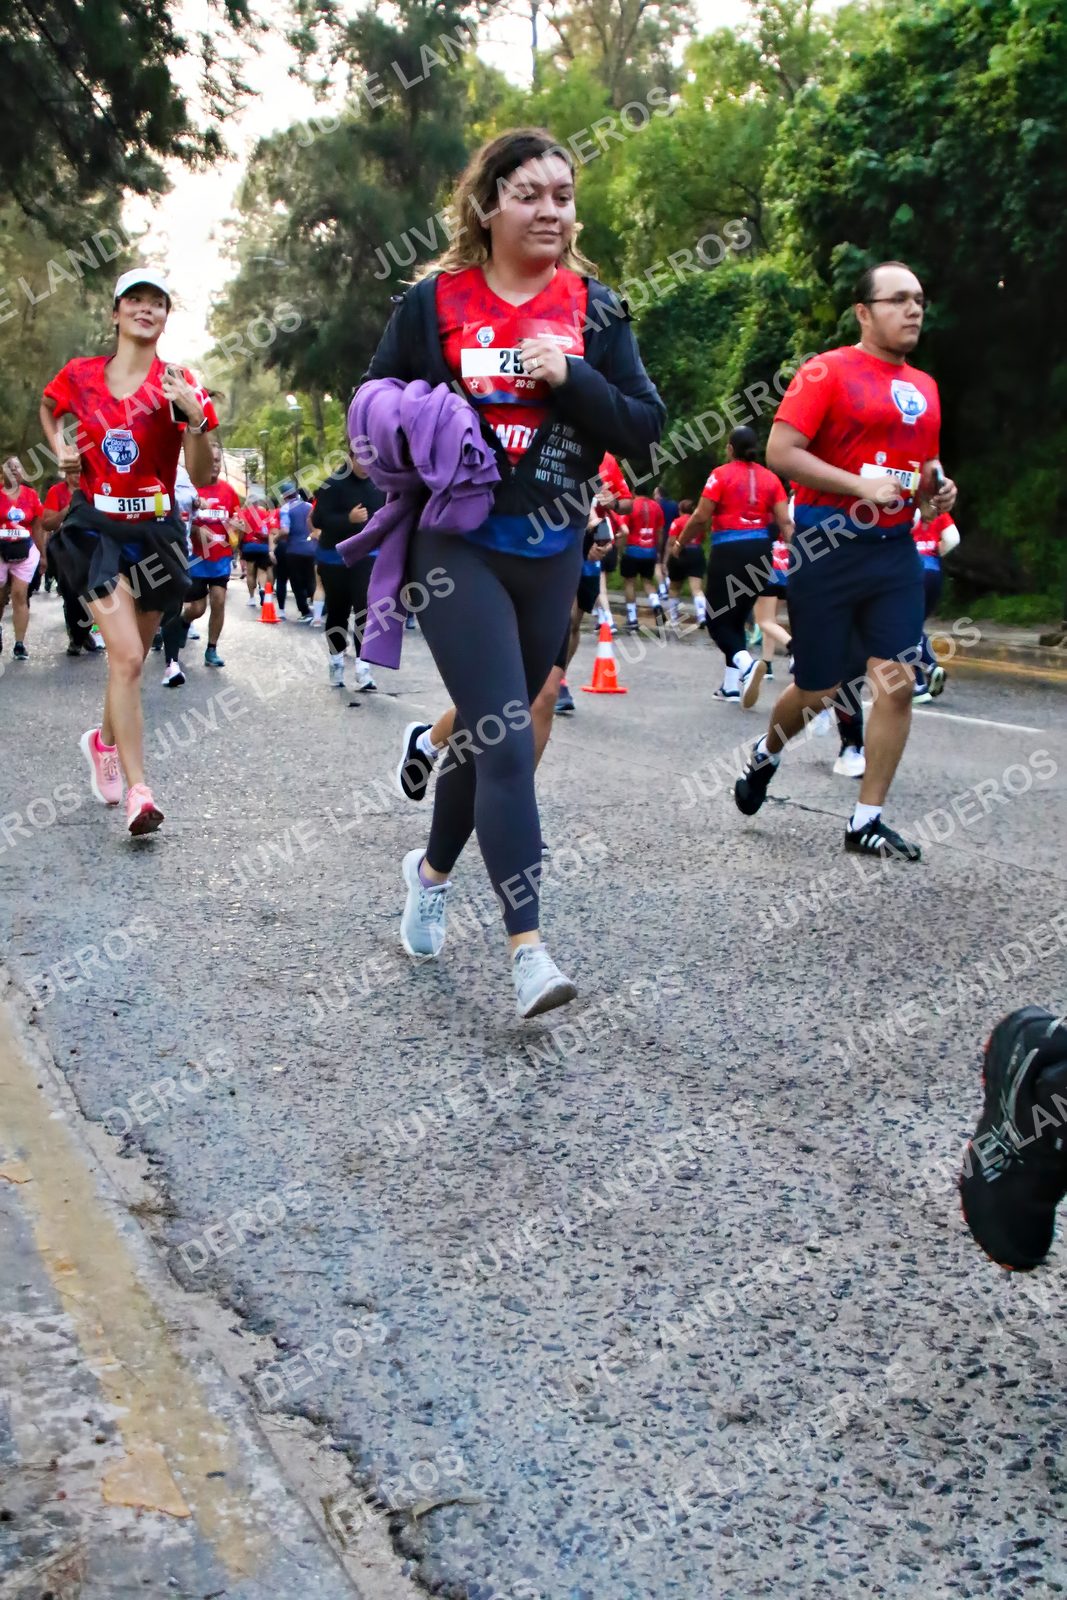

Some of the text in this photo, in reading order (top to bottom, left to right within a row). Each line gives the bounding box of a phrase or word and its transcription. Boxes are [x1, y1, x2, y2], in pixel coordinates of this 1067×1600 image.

[499, 350, 525, 374] 25
[540, 456, 550, 467] TO
[535, 468, 551, 482] NOT
[553, 473, 562, 485] TO
[118, 498, 146, 512] 3151
